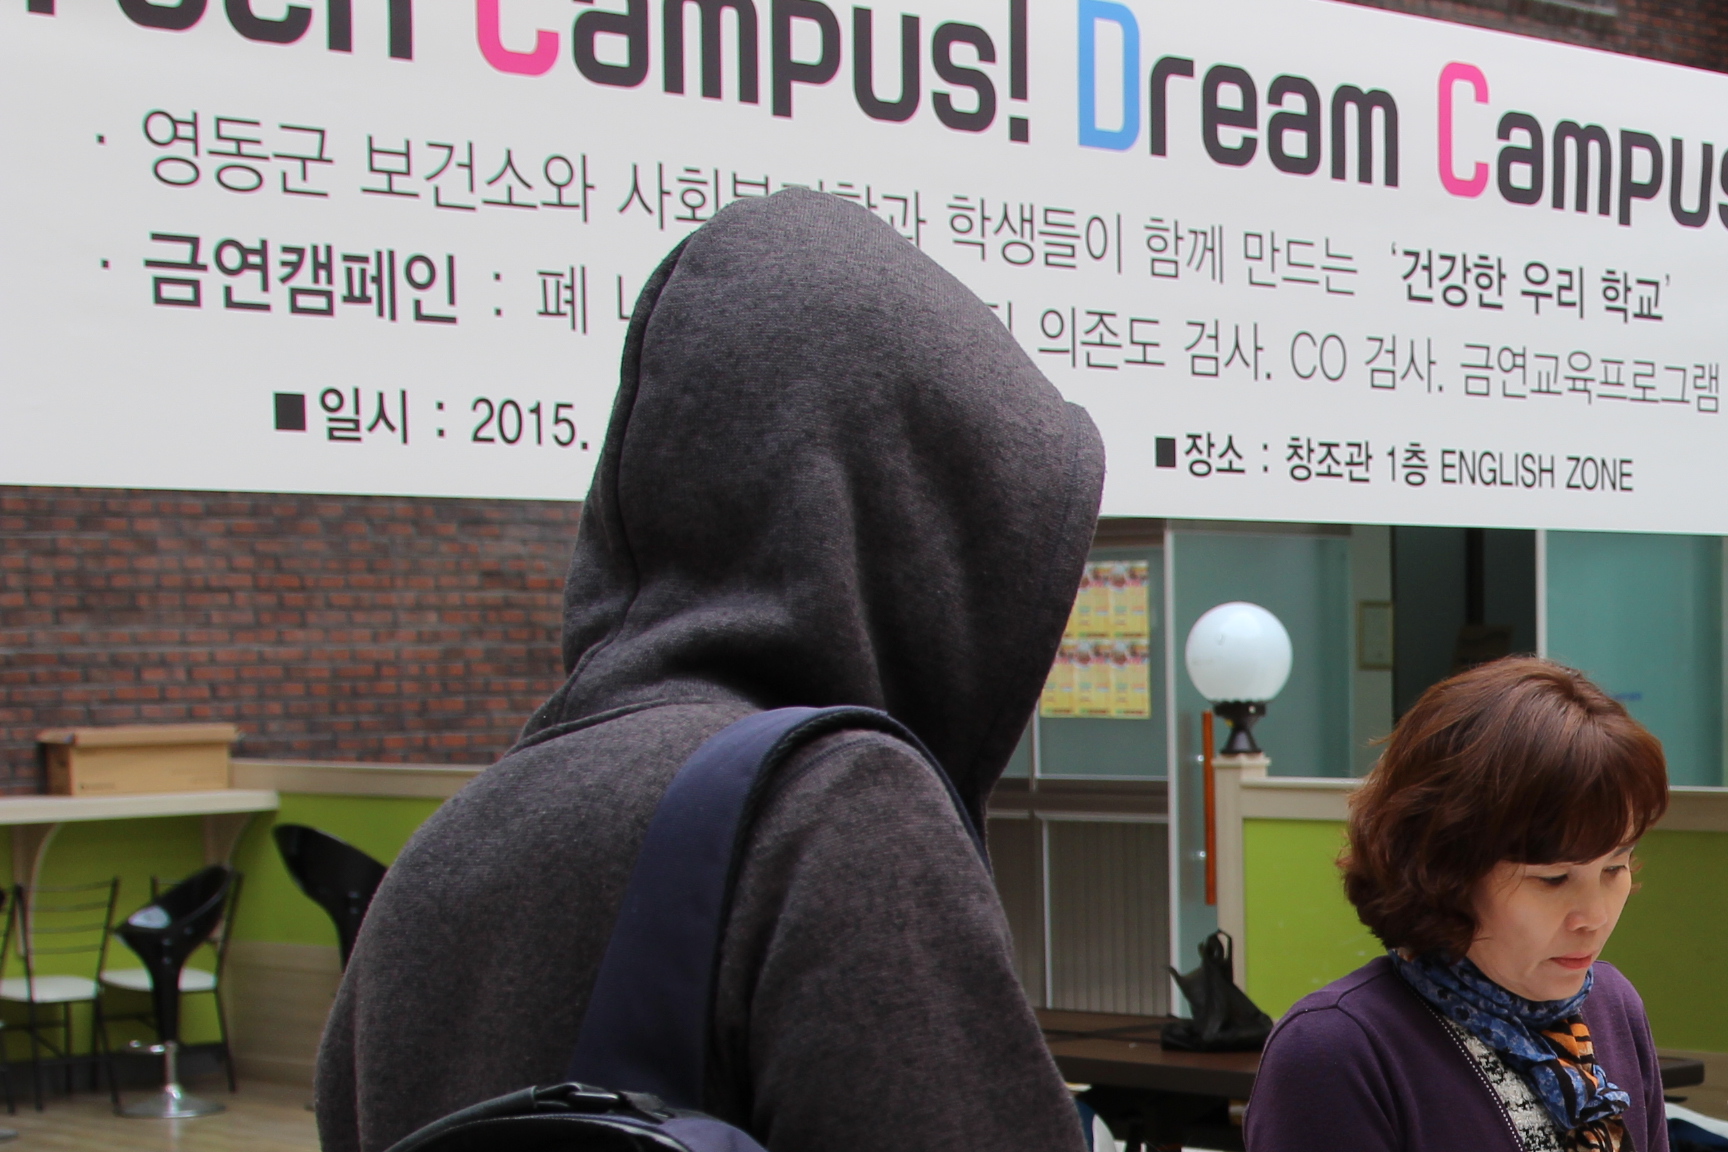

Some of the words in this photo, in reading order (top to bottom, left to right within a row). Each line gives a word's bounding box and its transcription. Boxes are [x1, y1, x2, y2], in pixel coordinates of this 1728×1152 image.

[1078, 0, 1398, 187] Dream
[143, 107, 335, 196] 영동군
[361, 134, 595, 223] 보건소와
[946, 194, 1124, 275] 학생들이
[1144, 215, 1225, 285] 함께
[1242, 229, 1358, 296] 만드는
[1520, 259, 1586, 319] 우리
[143, 232, 459, 325] 금연캠페인
[536, 262, 588, 335] 폐
[1038, 305, 1166, 369] 의존도
[1290, 331, 1347, 382] CO
[1460, 339, 1720, 414] 금연교육프로그램
[319, 386, 410, 445] 일시
[471, 398, 590, 451] 2015.
[1184, 431, 1246, 477] 장소
[1286, 436, 1374, 486] 창조관
[1387, 442, 1430, 487] 1층
[1441, 450, 1556, 490] ENGLISH
[1566, 456, 1634, 493] ZONE
